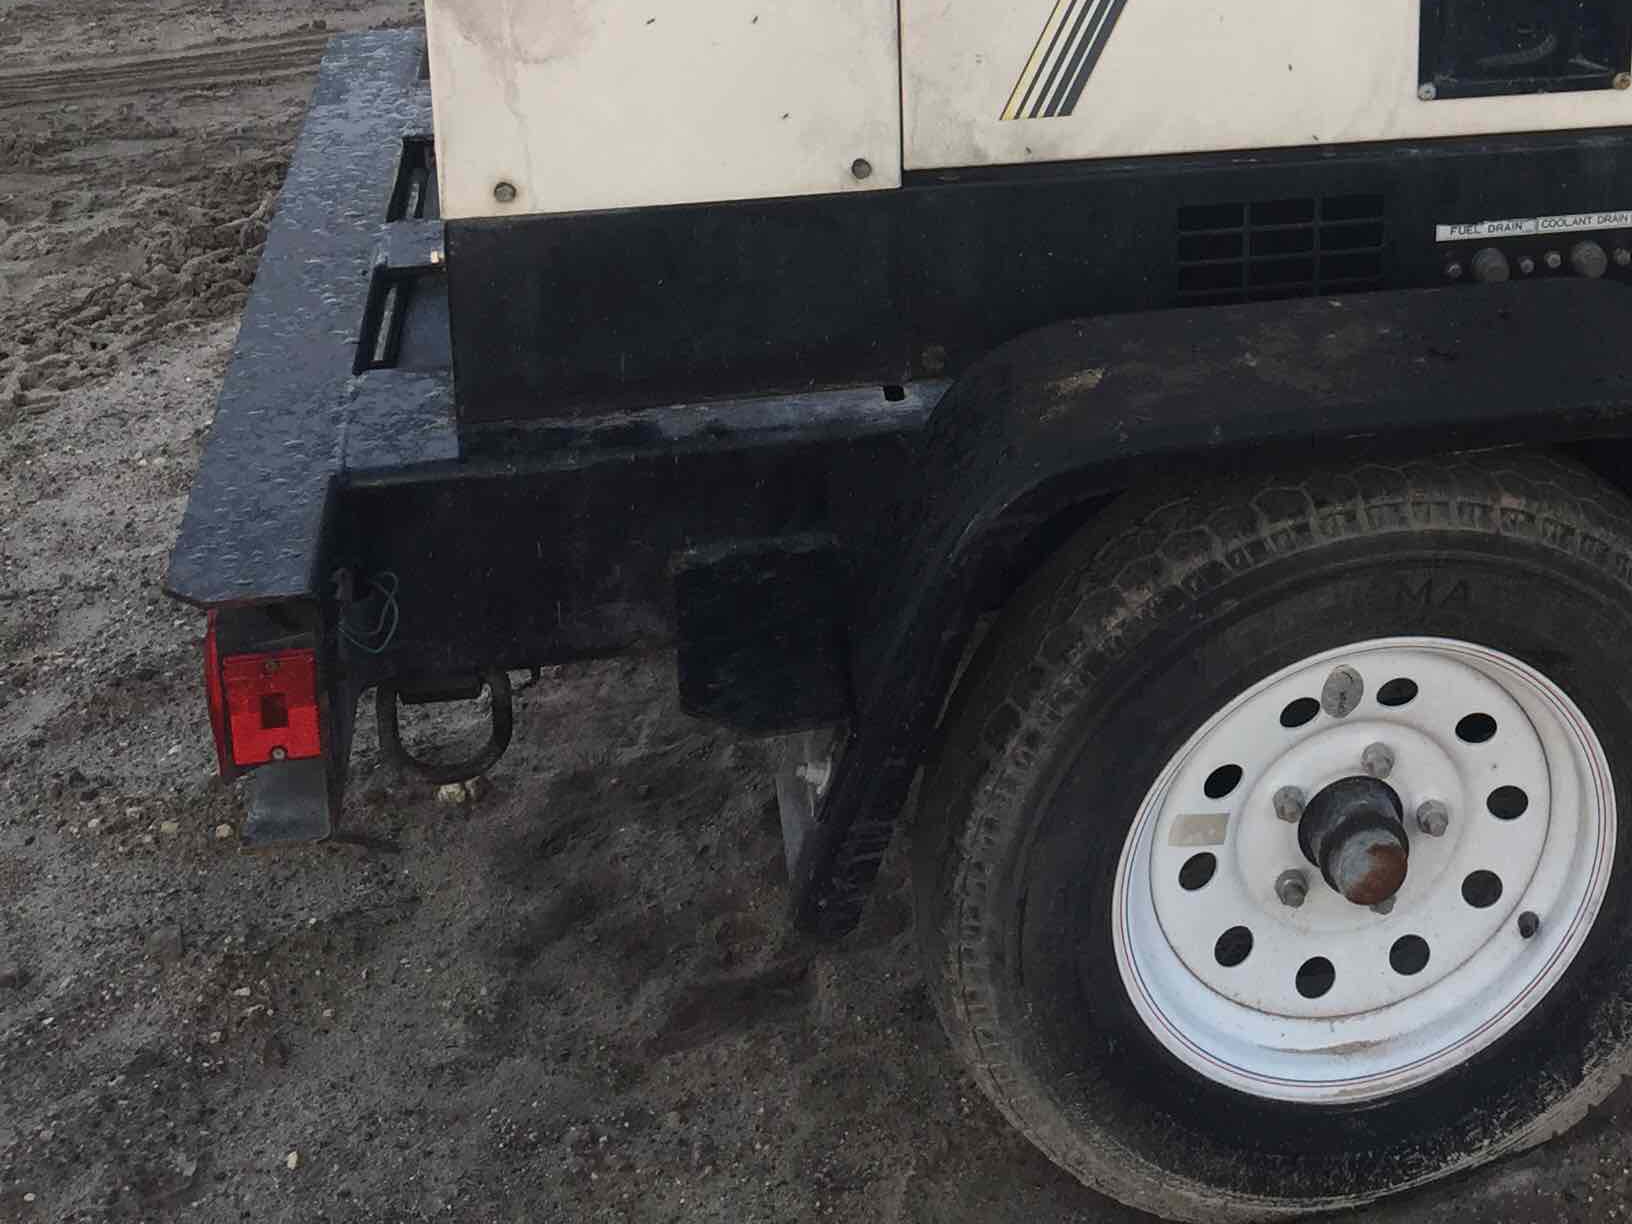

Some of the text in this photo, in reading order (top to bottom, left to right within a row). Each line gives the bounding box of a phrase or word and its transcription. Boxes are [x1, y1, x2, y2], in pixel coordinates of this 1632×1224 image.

[1542, 213, 1628, 229] COOLANT DRAIN
[1450, 222, 1523, 236] FUEL DRAIN
